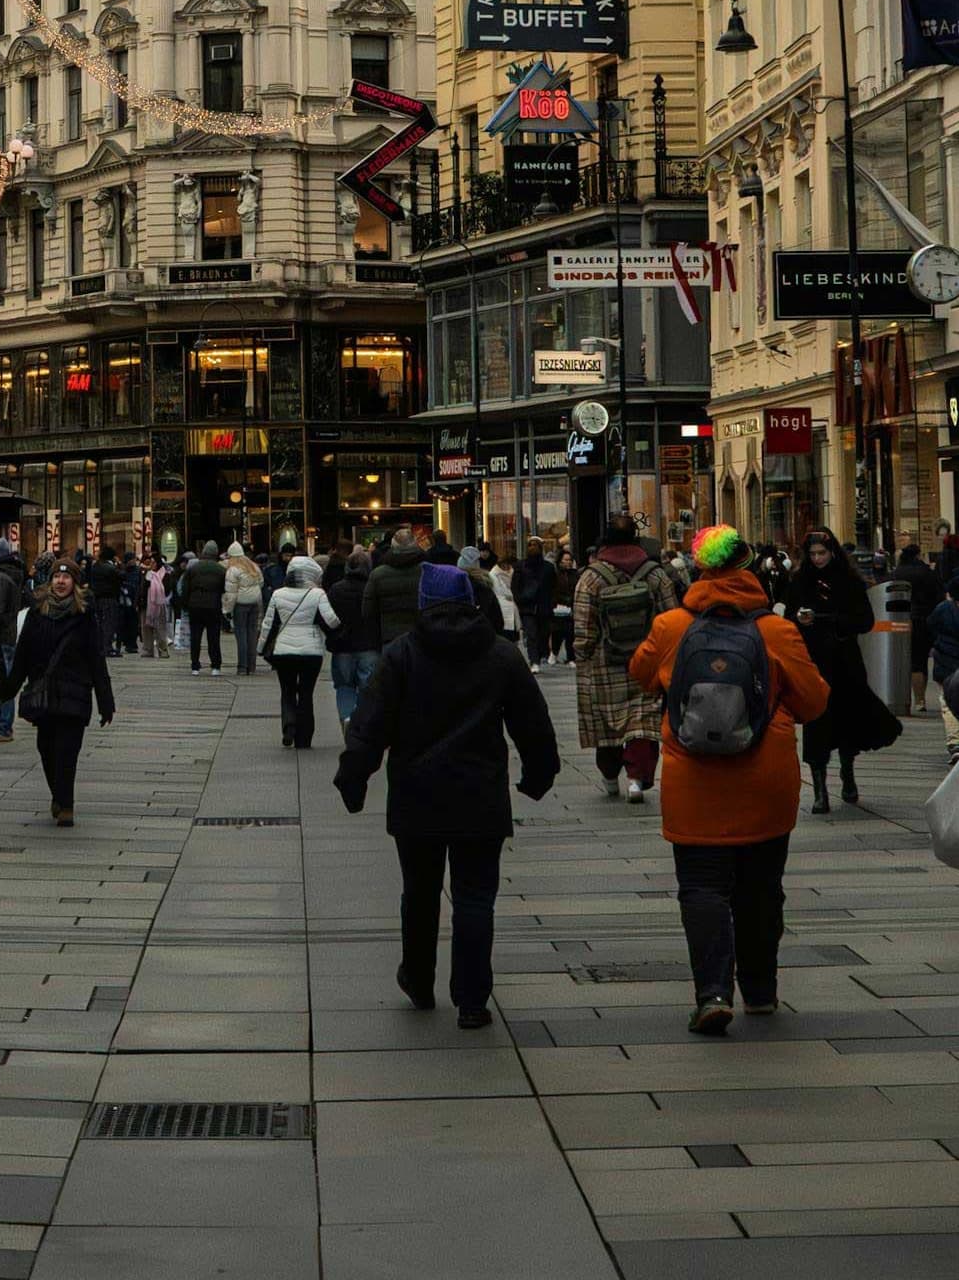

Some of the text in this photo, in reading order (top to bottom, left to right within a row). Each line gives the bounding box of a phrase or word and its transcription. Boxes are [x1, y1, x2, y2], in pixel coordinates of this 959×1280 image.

[503, 9, 587, 28] BUFFET
[356, 82, 424, 113] DISCOTHEQUE
[567, 256, 615, 264] GALERIE
[66, 373, 92, 391] H&M
[770, 415, 807, 431] högl
[490, 456, 508, 472] GIFTS
